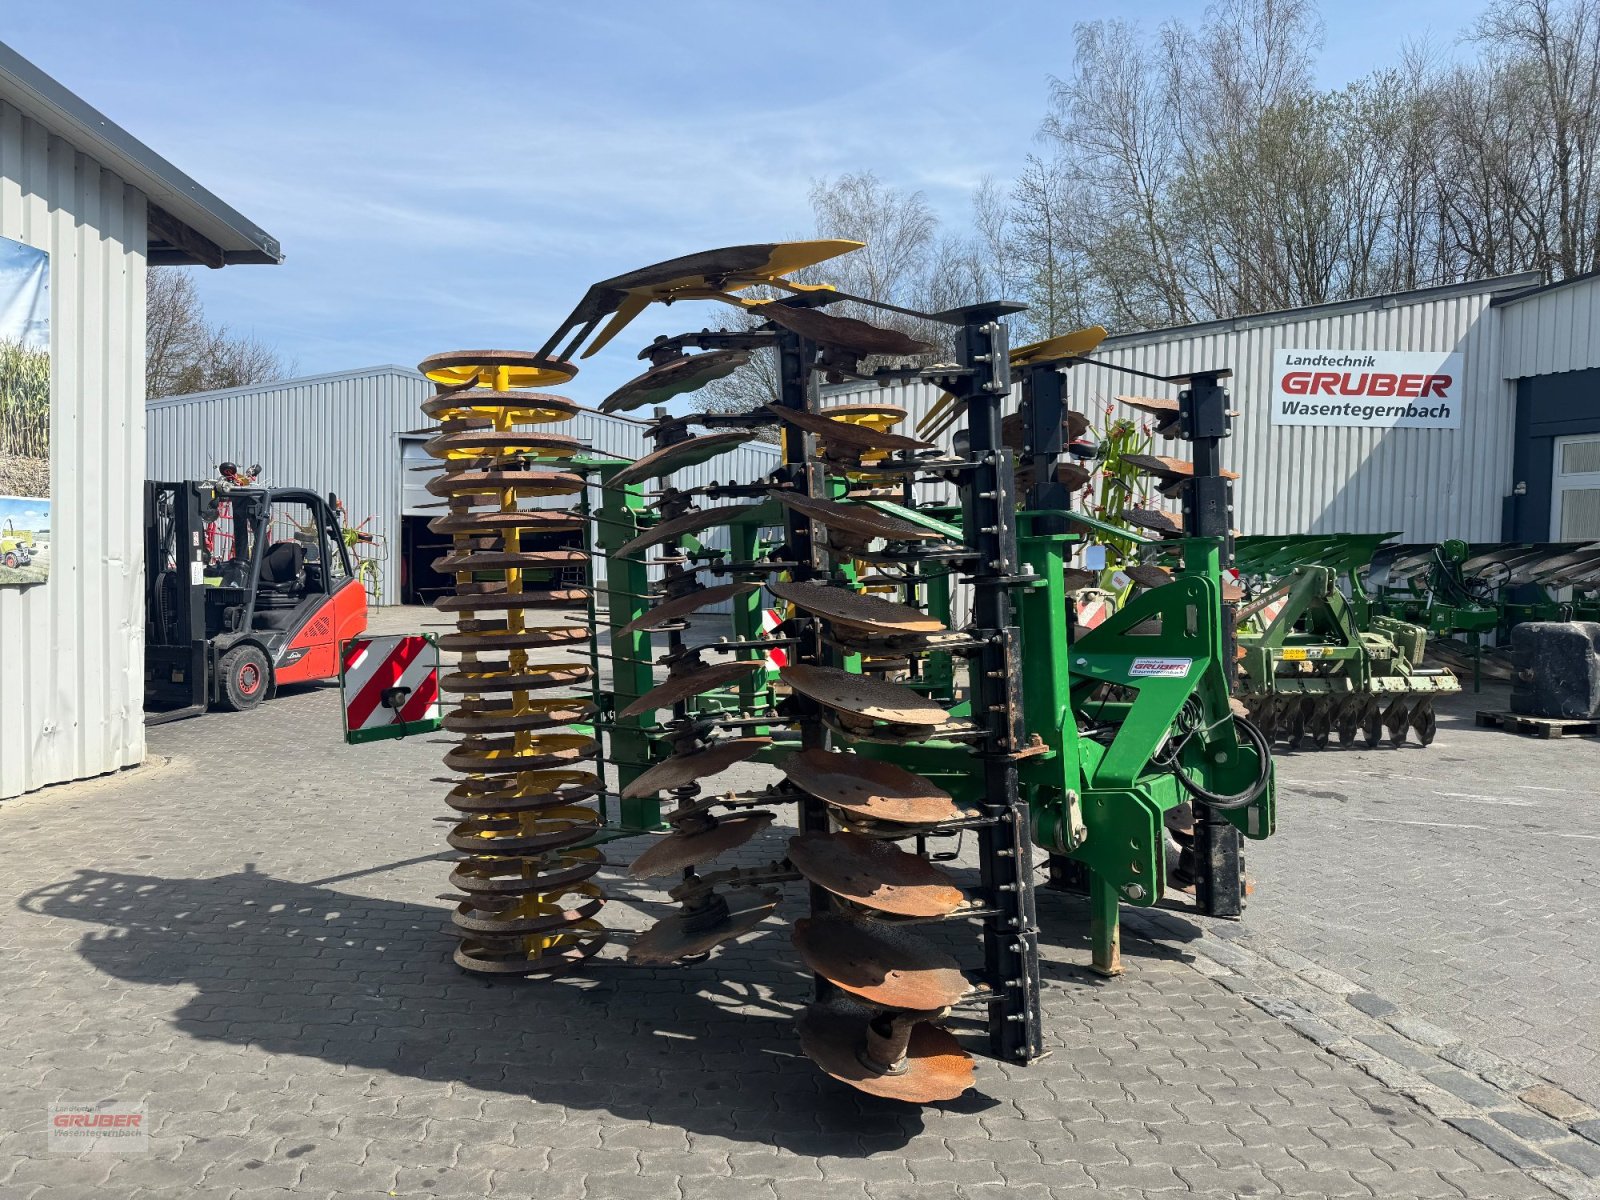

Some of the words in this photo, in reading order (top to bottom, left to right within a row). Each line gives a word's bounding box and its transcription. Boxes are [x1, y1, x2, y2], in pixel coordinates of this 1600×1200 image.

[1286, 354, 1376, 367] Landtechnik
[1281, 371, 1453, 398] GRUBER
[1282, 401, 1450, 420] Wasentegernbach
